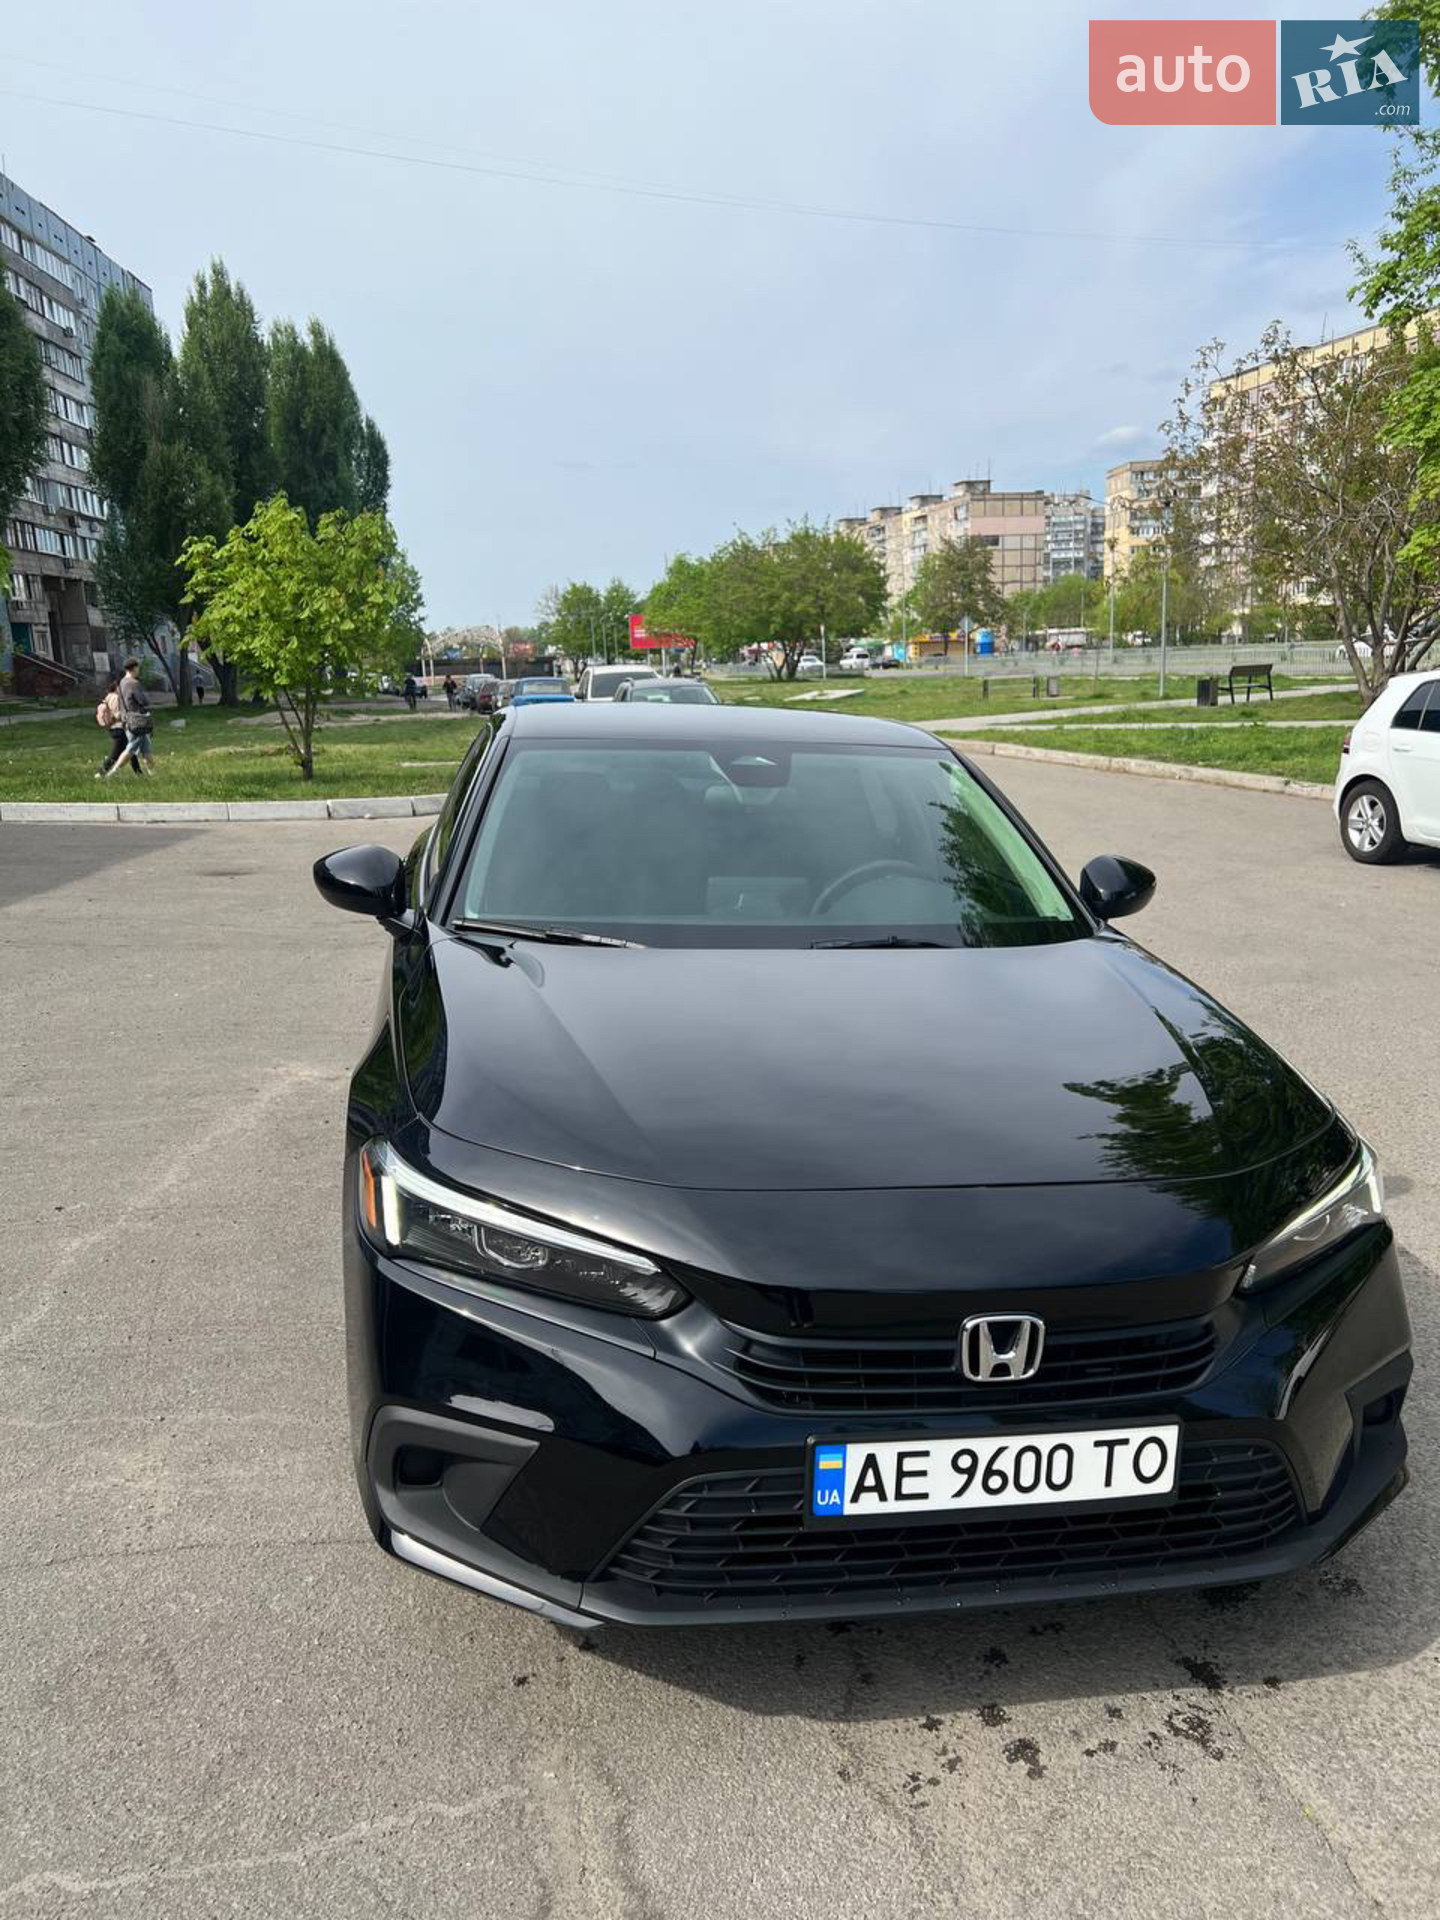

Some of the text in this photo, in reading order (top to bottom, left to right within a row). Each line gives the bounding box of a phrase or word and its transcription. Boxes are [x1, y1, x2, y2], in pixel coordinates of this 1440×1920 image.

[850, 1436, 1168, 1503] AE 9600 TO
[816, 1489, 841, 1506] UA
